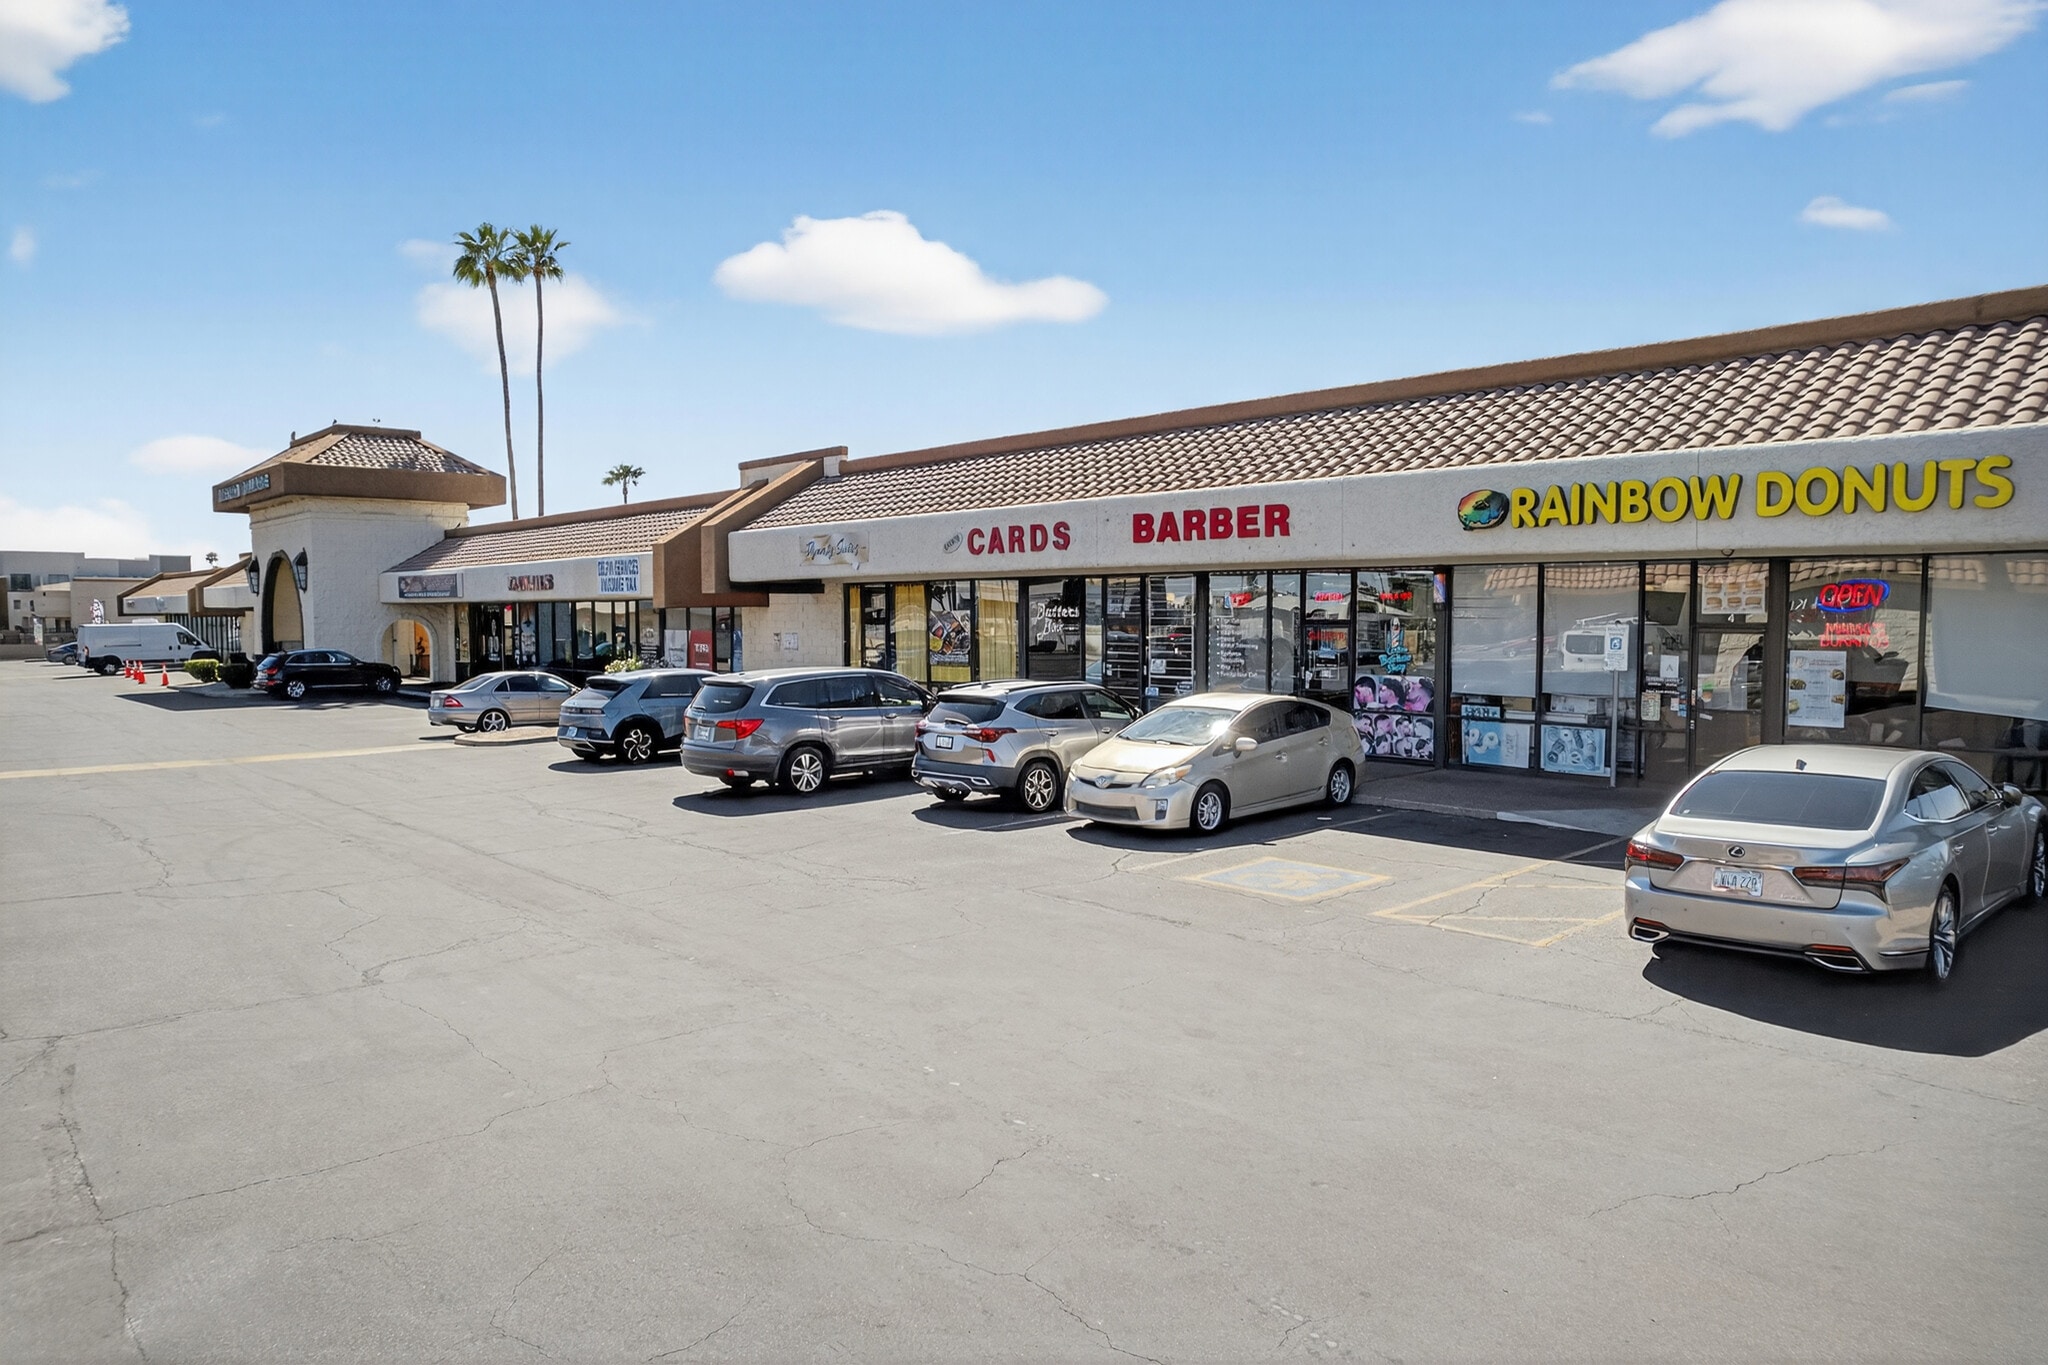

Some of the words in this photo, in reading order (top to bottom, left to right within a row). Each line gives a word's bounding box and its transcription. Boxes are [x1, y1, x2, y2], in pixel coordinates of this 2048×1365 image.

[1510, 473, 1742, 529] RAINBOW
[1756, 455, 2016, 518] DONUTS
[967, 521, 1072, 556] CARDS
[1132, 503, 1291, 544] BARBER
[1819, 583, 1885, 608] OPEN
